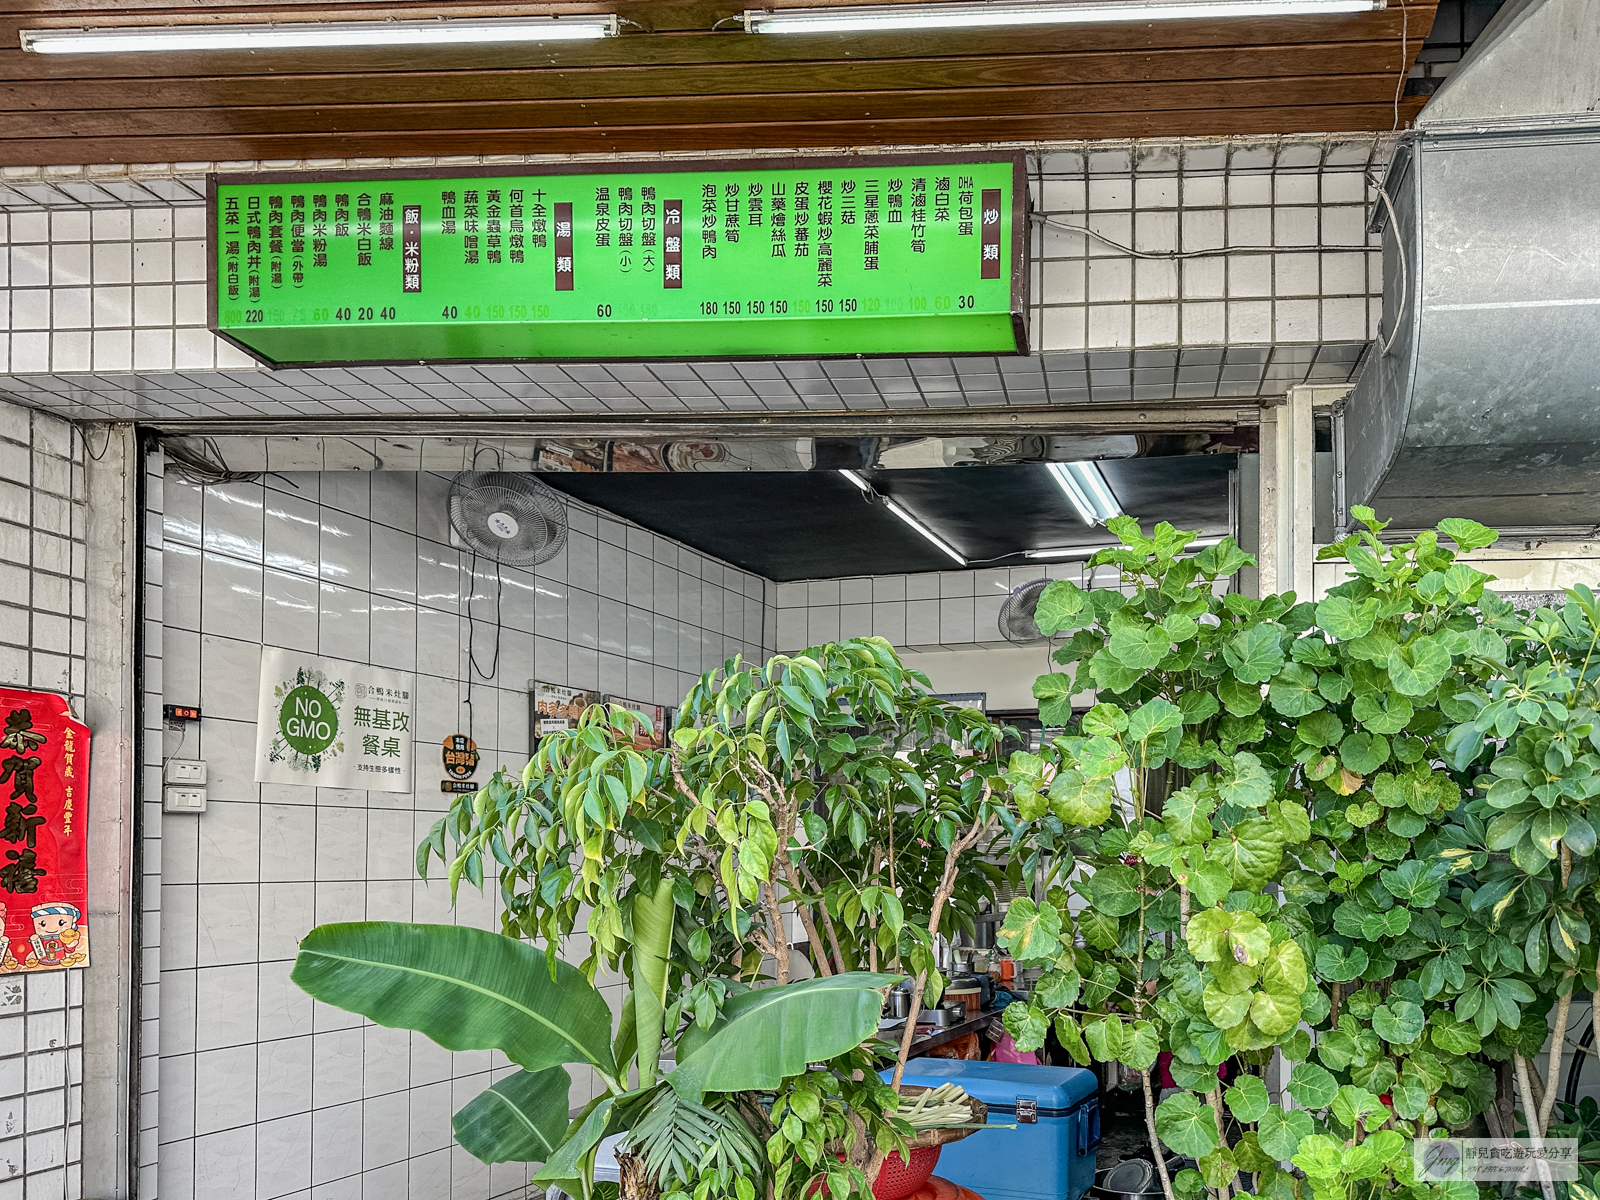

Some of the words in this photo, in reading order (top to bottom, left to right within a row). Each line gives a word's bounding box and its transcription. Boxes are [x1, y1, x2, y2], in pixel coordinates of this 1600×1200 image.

[748, 182, 763, 227] 炒雲耳
[840, 179, 856, 225] 炒三菇
[887, 178, 903, 223] 炒鴨血
[934, 176, 950, 222] 滷白菜
[335, 193, 349, 237] 鴨肉飯
[379, 192, 394, 251] 麻油麵線
[441, 190, 456, 235] 鴨血湯
[532, 188, 547, 248] 十全燉鴨
[701, 183, 717, 259] 泡菜炒鴨肉
[725, 183, 740, 243] 炒甘蔗筍
[771, 181, 786, 258] 山藥燴絲瓜
[911, 177, 926, 254] 清滷桂竹筍
[312, 194, 328, 267] 鴨肉米粉湯
[357, 192, 372, 266] 合鴨米白飯
[464, 190, 479, 264] 蔬菜味噌湯
[486, 189, 502, 264] 黃金蟲草鴨
[817, 180, 832, 287] 櫻花蝦炒高麗菜
[983, 208, 999, 260] 炒類
[556, 221, 572, 273] 湯類
[665, 208, 681, 281] 冷盤類
[358, 307, 373, 320] 20
[380, 306, 396, 320] 40
[442, 306, 457, 319] 40
[464, 305, 480, 318] 40
[487, 305, 504, 318] 150
[509, 304, 527, 318] 150
[531, 304, 550, 318] 150
[597, 304, 612, 317] 60
[700, 301, 718, 315] 180
[723, 301, 741, 314] 150
[747, 300, 765, 314] 150
[770, 300, 788, 314] 150
[793, 300, 811, 313] 150
[815, 299, 833, 313] 150
[839, 298, 857, 312] 150
[862, 297, 880, 312] 120
[909, 296, 927, 310] 100
[934, 295, 951, 310] 60
[958, 295, 974, 309] 30
[245, 309, 263, 323] 220
[313, 308, 329, 321] 60
[335, 307, 351, 321] 40
[295, 697, 322, 718] NO
[354, 705, 410, 733] 無基改
[286, 717, 331, 740] GMO
[362, 733, 401, 758] 餐桌
[0, 708, 47, 894] 恭賀新禧
